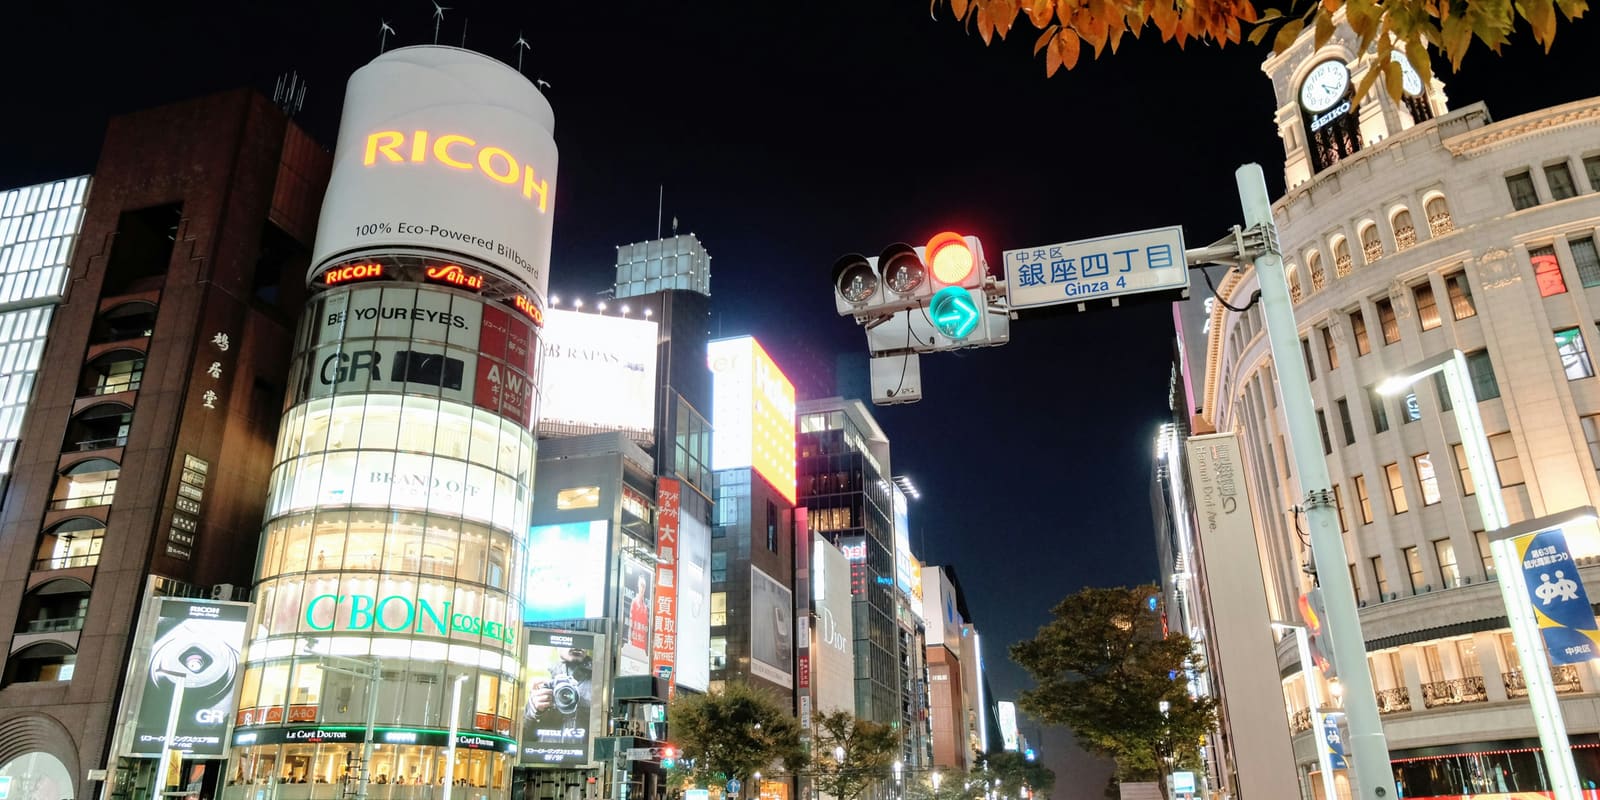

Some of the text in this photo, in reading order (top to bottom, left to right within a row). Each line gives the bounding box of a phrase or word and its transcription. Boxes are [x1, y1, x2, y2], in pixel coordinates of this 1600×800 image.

[1311, 101, 1350, 132] SEIKO
[363, 130, 548, 213] RICOH
[355, 222, 539, 280] 100% Eco-Powered Billboard
[1015, 247, 1063, 263] 中央区
[325, 264, 382, 285] RICOH
[1018, 244, 1173, 287] 銀座四丁目
[1064, 275, 1127, 297] Ginza 4
[328, 307, 469, 330] BE YOUR EYES.
[320, 350, 381, 385] GR
[1207, 511, 1217, 533] Ave.
[190, 605, 220, 613] RICOH
[654, 615, 674, 633] 買取
[823, 607, 847, 654] Dior
[653, 632, 674, 650] 販売
[1565, 644, 1591, 655] 中央区
[195, 709, 224, 724] GR
[286, 731, 296, 739] LE
[316, 730, 347, 738] DOUTOR
[562, 727, 586, 738] K-3
